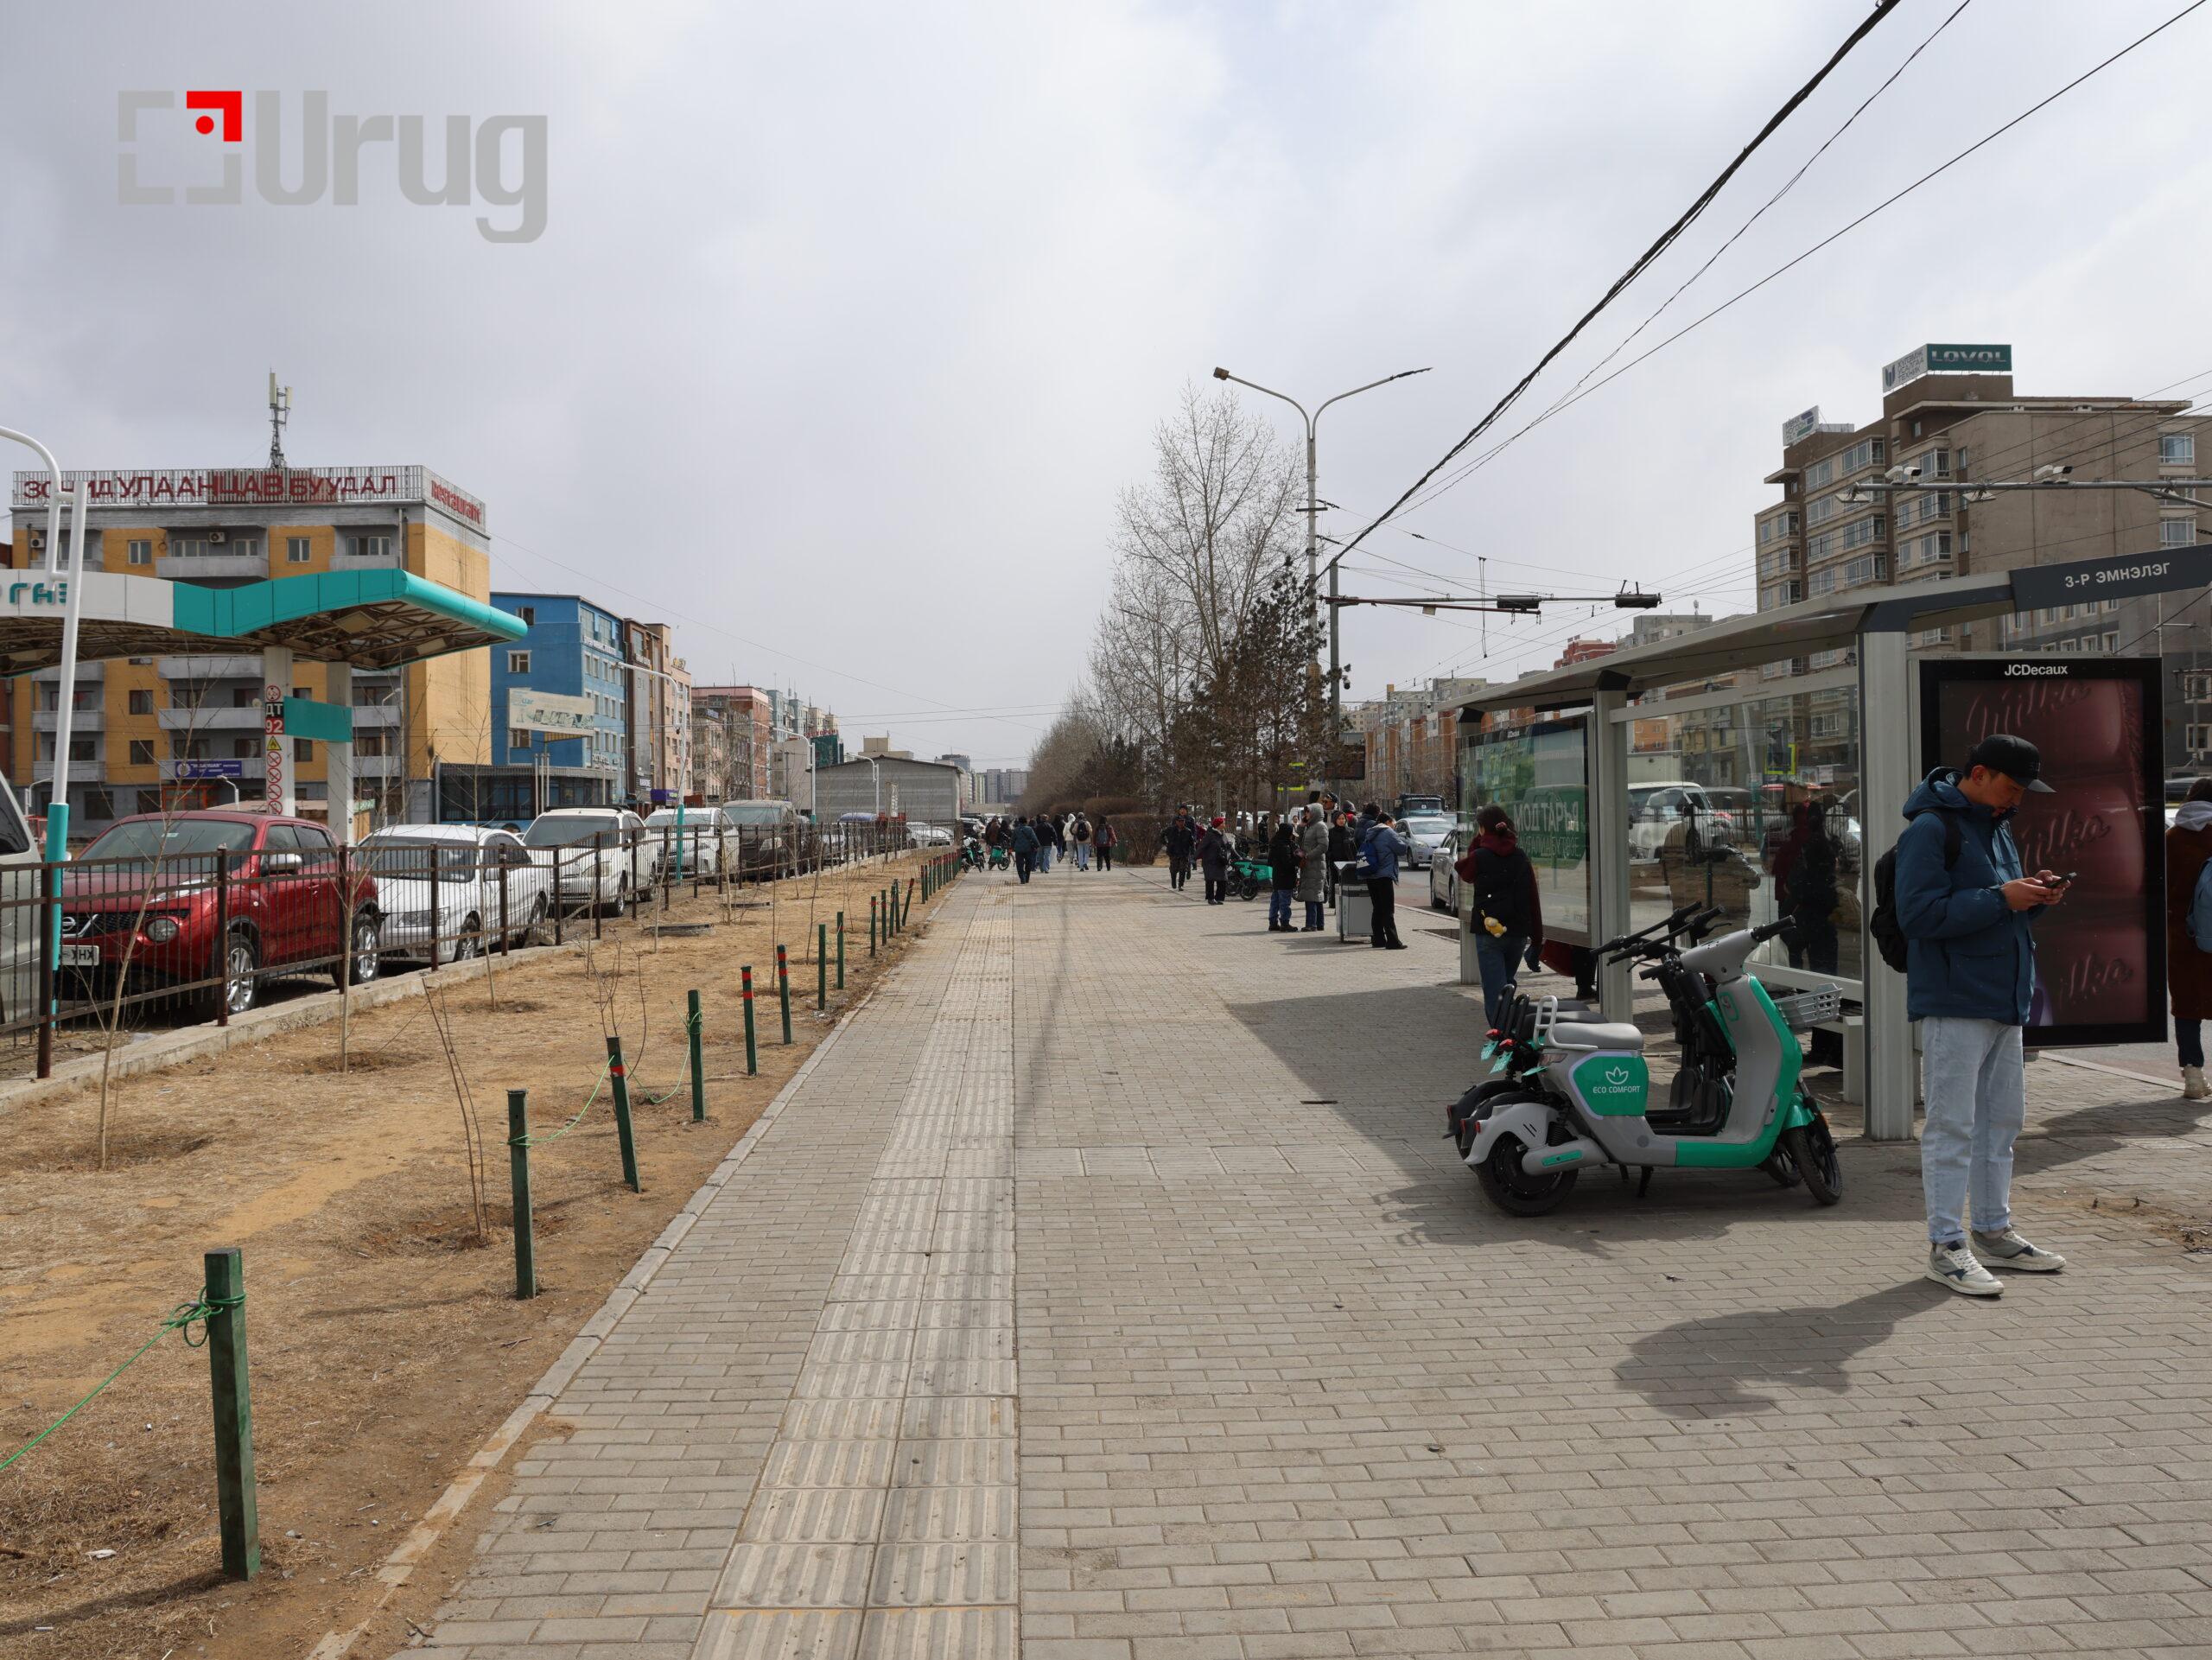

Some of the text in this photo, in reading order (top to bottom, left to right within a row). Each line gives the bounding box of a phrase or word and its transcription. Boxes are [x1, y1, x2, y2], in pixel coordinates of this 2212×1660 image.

[1931, 350, 2006, 363] LOVOL
[116, 474, 284, 499] УЛААНЦАВ
[289, 474, 397, 497] БУУДАЛ
[2095, 562, 2171, 583] ЭМНЭЛЭГ
[2004, 664, 2069, 676] JCDecaux
[265, 703, 283, 716] ДТ
[264, 719, 283, 734] 92
[1513, 802, 1540, 832] МОД
[2022, 809, 2110, 876] ilka
[2060, 953, 2134, 1010] ilka
